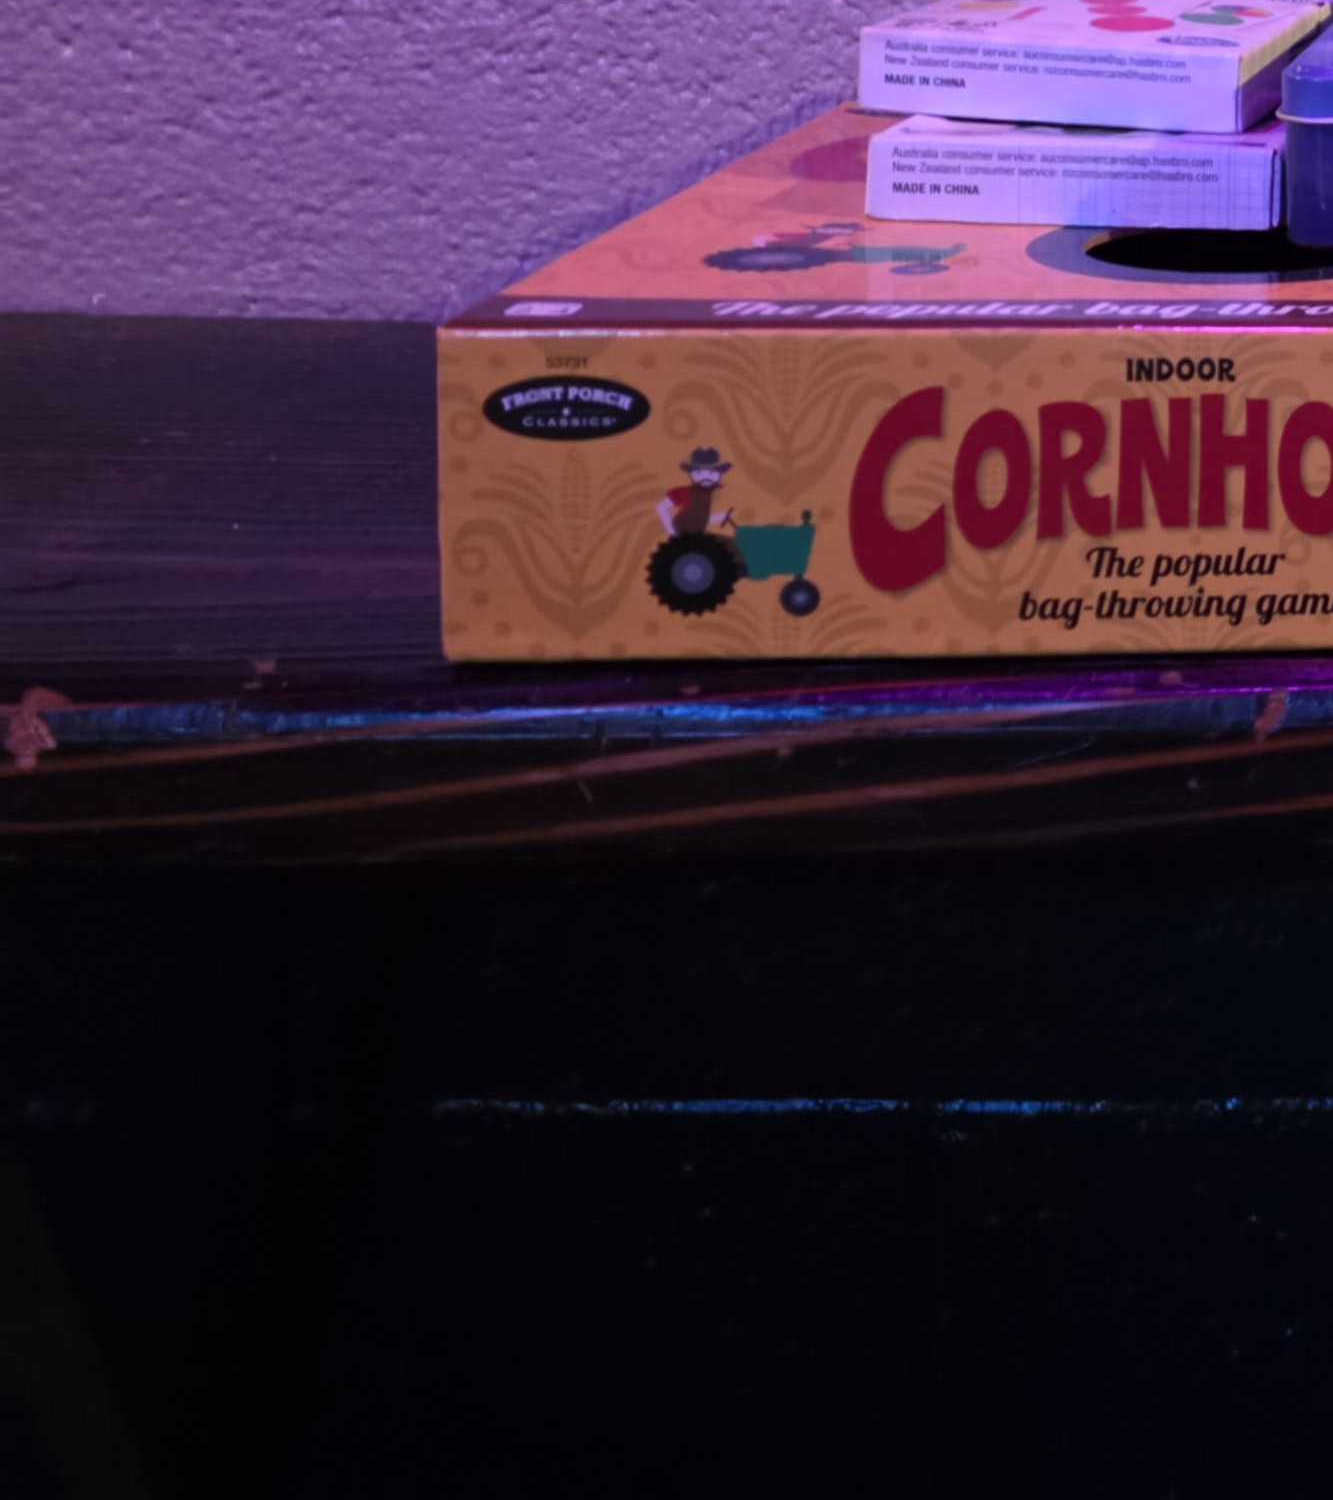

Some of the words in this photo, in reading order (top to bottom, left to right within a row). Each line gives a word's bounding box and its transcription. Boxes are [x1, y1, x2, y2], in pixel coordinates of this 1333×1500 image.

[885, 39, 928, 52] Australia
[931, 43, 979, 56] consumer
[885, 54, 908, 66] New
[910, 56, 949, 68] Zealand
[952, 60, 999, 71] consumer
[885, 73, 915, 86] MADE
[919, 76, 930, 86] IN
[933, 77, 966, 88] CHINA
[892, 146, 939, 159] Australia
[941, 150, 993, 161] consumer
[892, 161, 916, 173] New
[919, 162, 961, 174] Zealand
[964, 165, 1015, 176] consumer
[892, 182, 925, 194] MADE
[930, 184, 941, 194] IN
[944, 184, 980, 196] CHINA
[711, 301, 816, 317] The
[813, 301, 1074, 319] popular
[545, 357, 588, 369] 53731
[1126, 357, 1235, 383] INDOOR
[502, 386, 565, 411] FRONT
[567, 386, 633, 411] PORCH
[522, 416, 612, 427] CLASSICS
[1085, 547, 1144, 580] The
[1150, 547, 1285, 586] popular
[1018, 581, 1247, 629] bag-throwing
